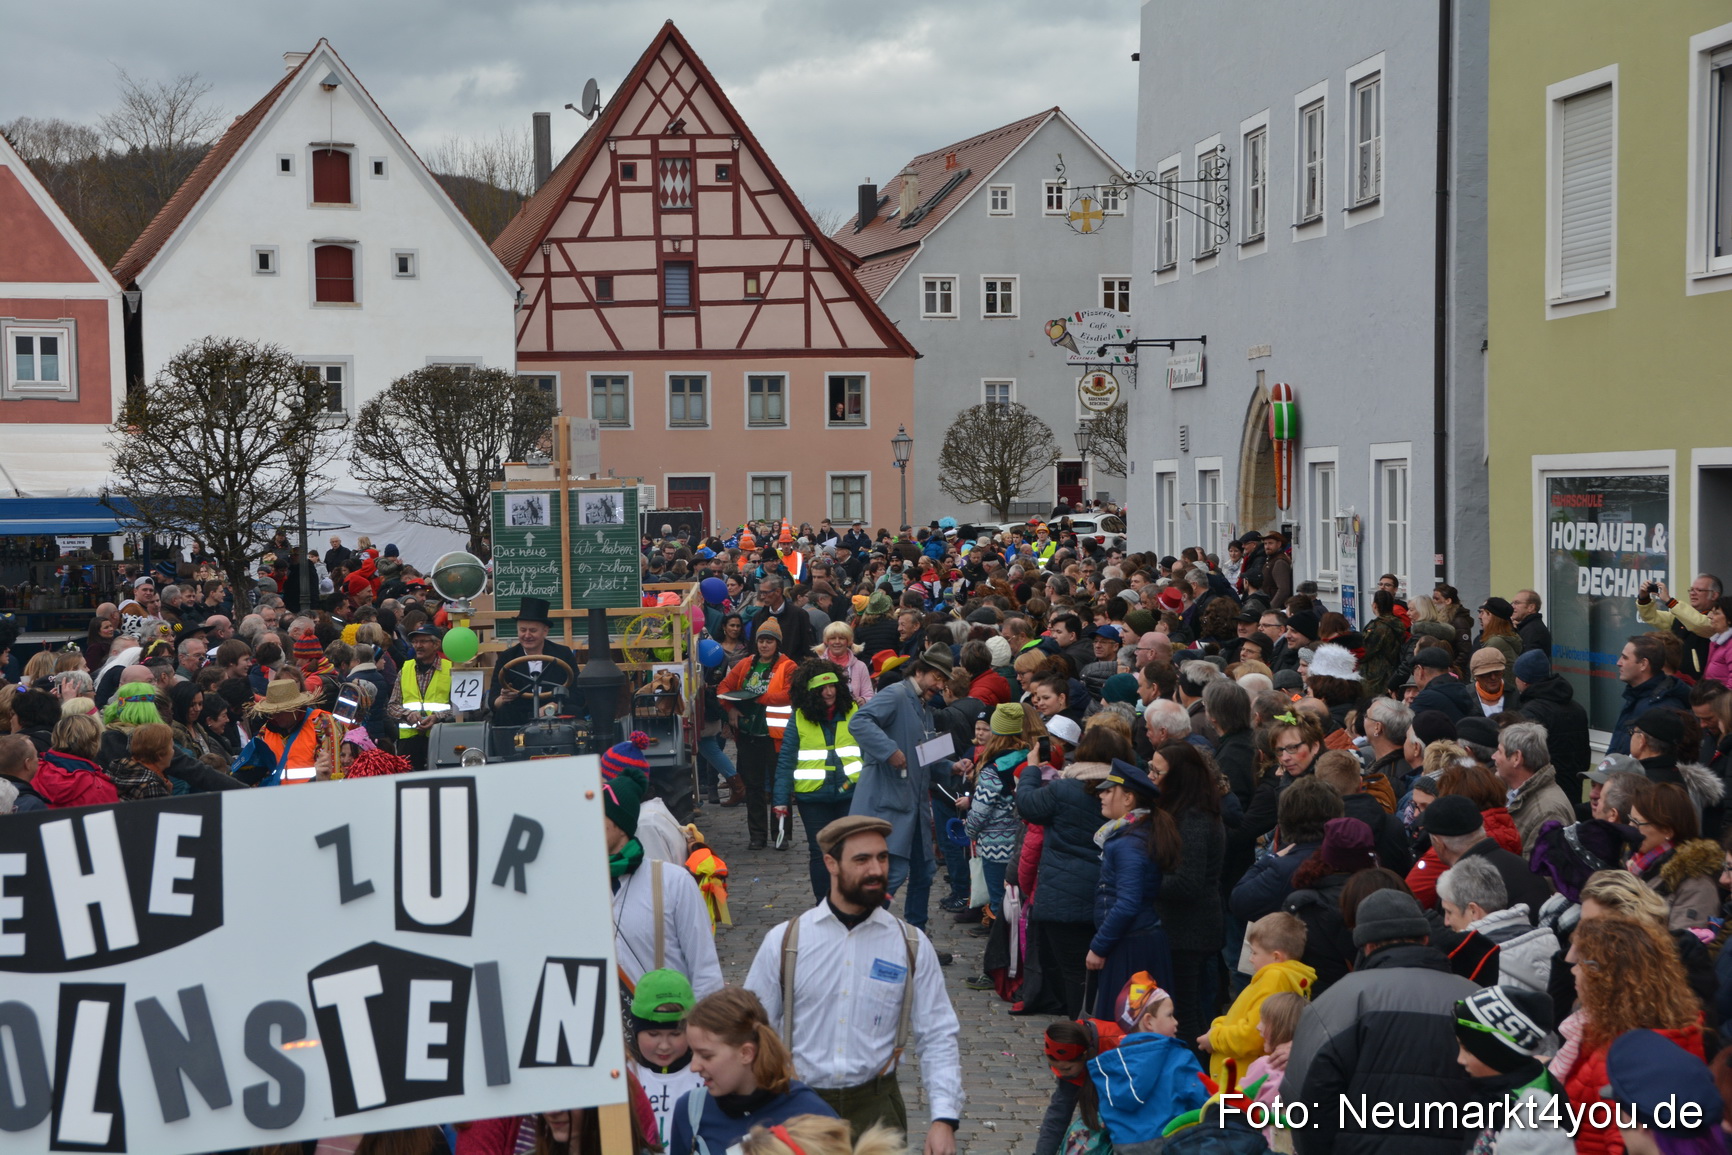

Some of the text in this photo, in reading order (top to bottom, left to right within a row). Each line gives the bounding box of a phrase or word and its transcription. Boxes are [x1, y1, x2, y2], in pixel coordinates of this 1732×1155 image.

[1081, 310, 1115, 319] Pizzeria
[1089, 321, 1107, 331] Café
[1080, 332, 1116, 342] Eisdiele
[1551, 494, 1604, 508] FAHRSCHULE
[1551, 521, 1666, 553] HOFBAUER &
[492, 545, 547, 558] Das neue
[574, 539, 634, 555] Wir haben
[578, 559, 634, 573] es schon
[497, 577, 561, 597] Schulkonzept
[454, 679, 479, 698] 42
[315, 787, 544, 926] ZUR
